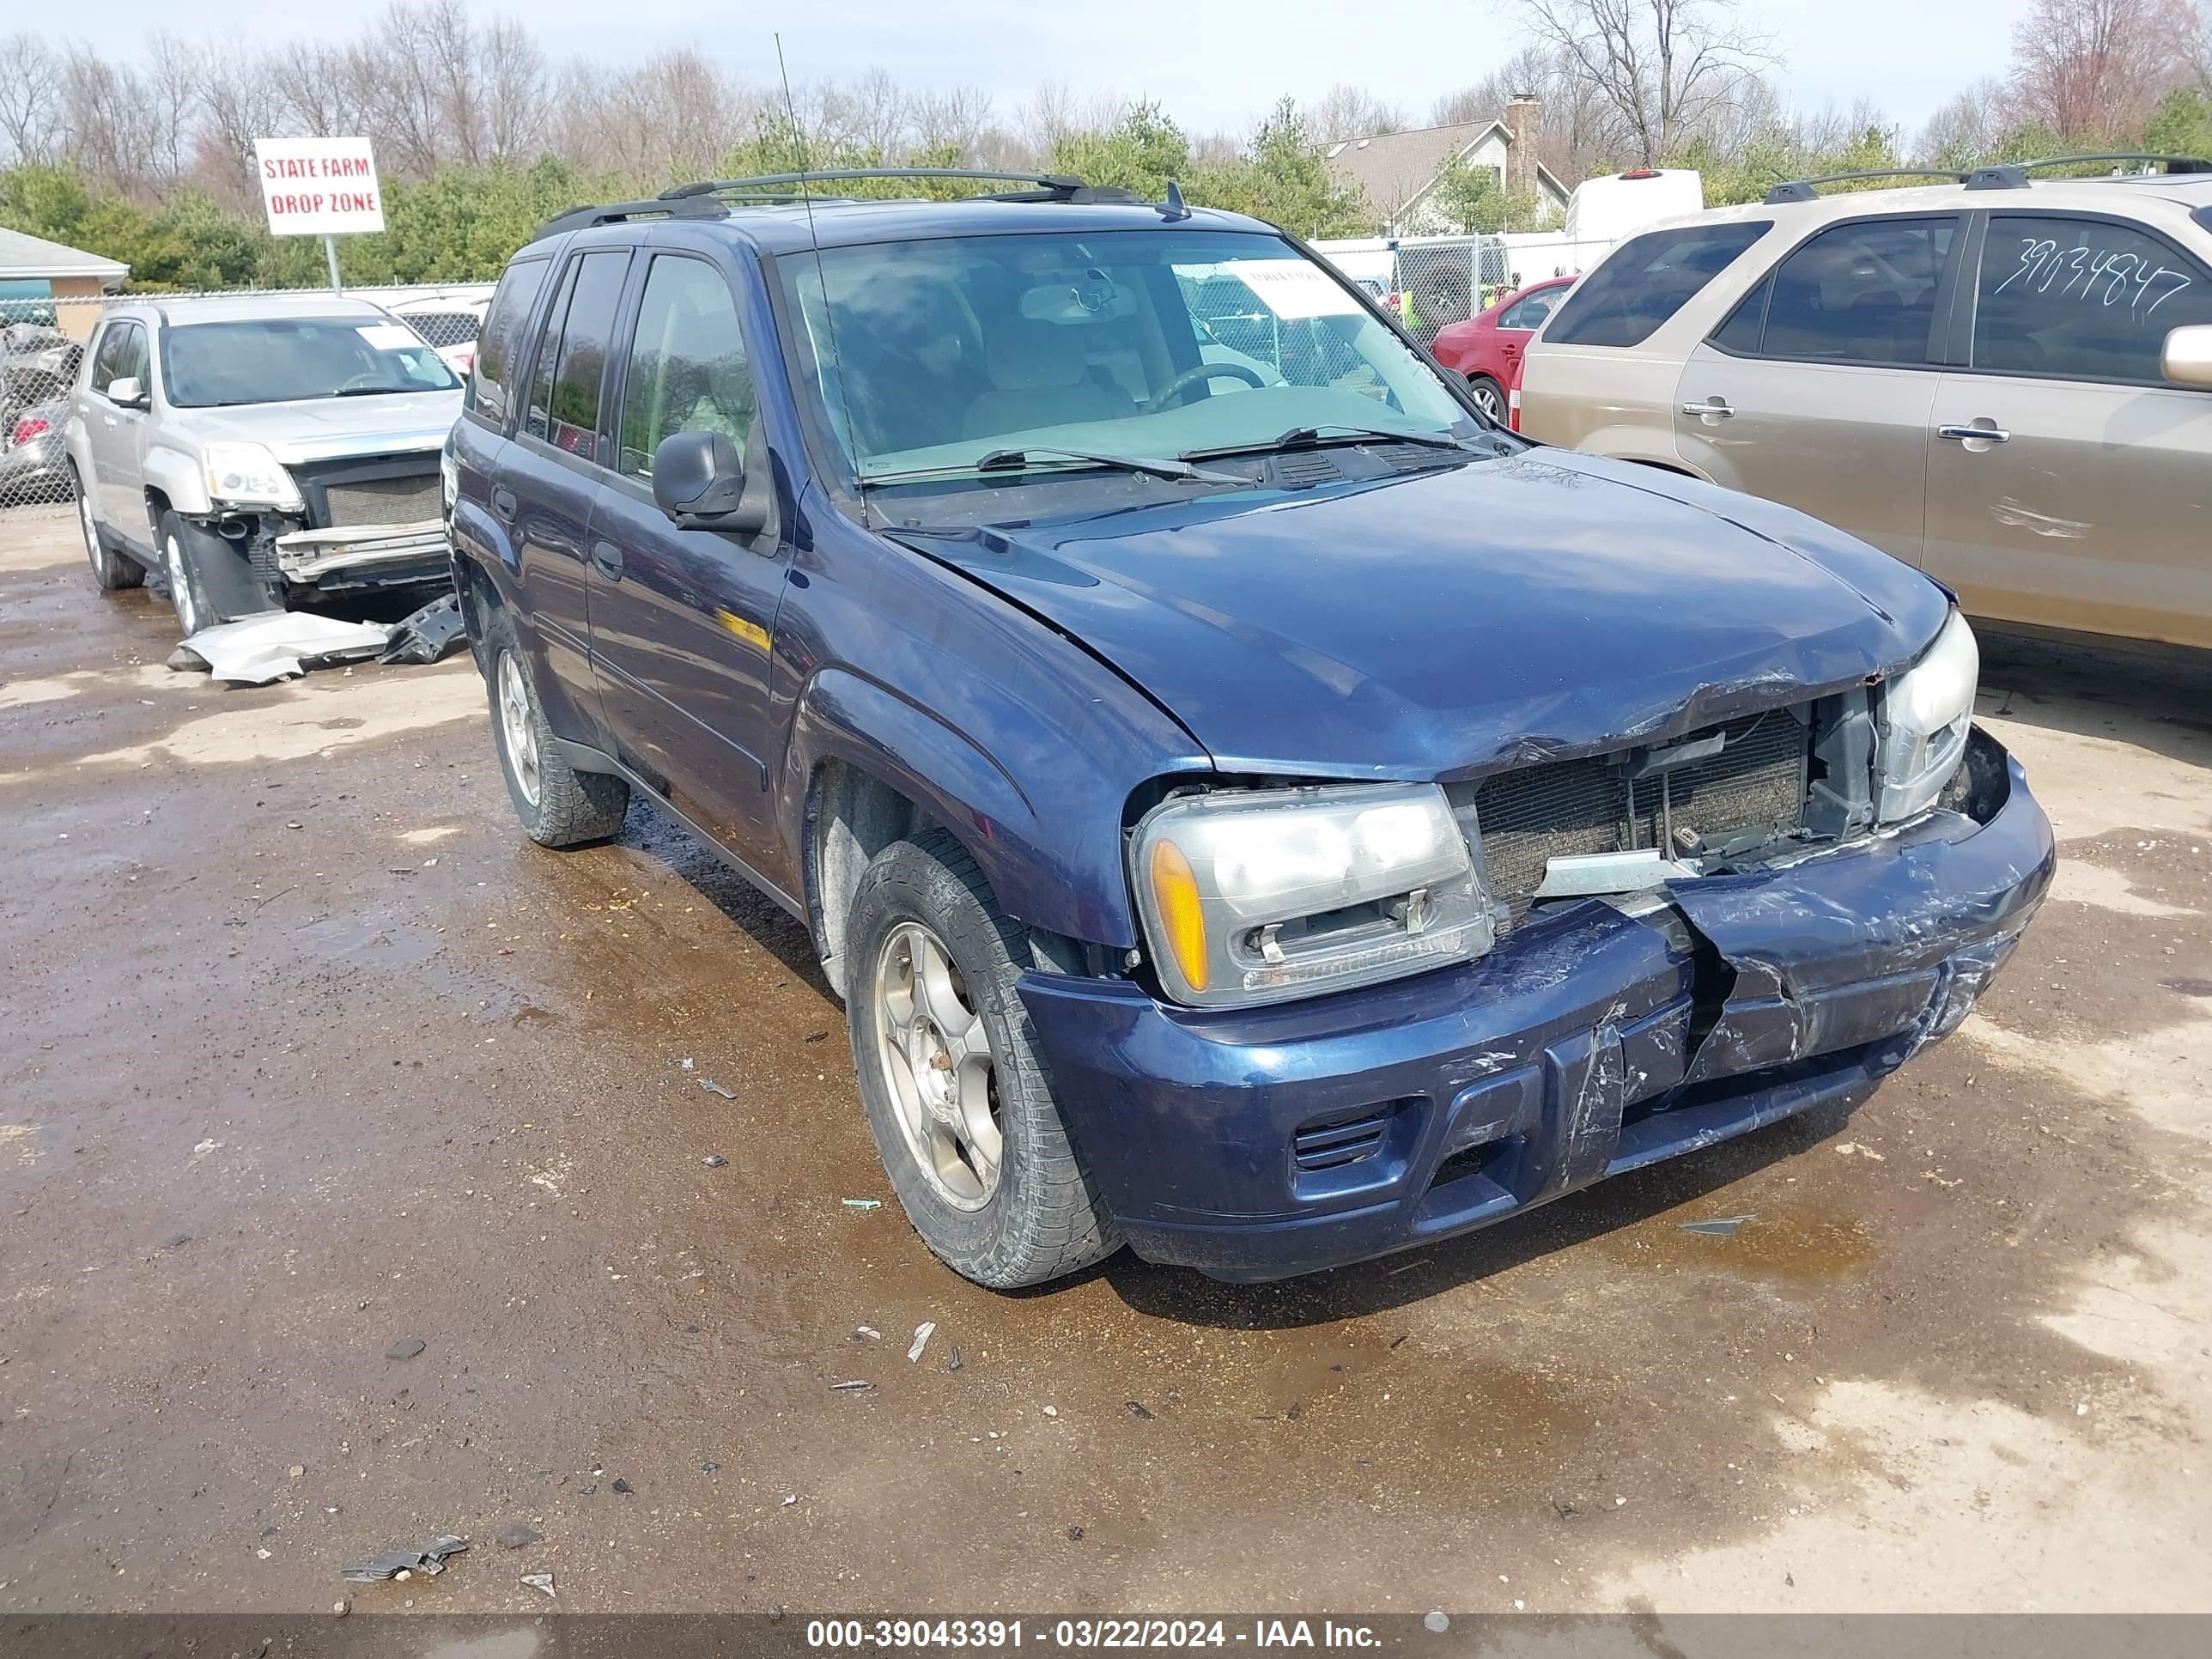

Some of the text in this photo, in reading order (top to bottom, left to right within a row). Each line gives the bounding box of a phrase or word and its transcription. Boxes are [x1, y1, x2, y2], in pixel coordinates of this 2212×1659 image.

[264, 157, 370, 179] STATE FARM
[271, 192, 376, 214] DROP ZONE
